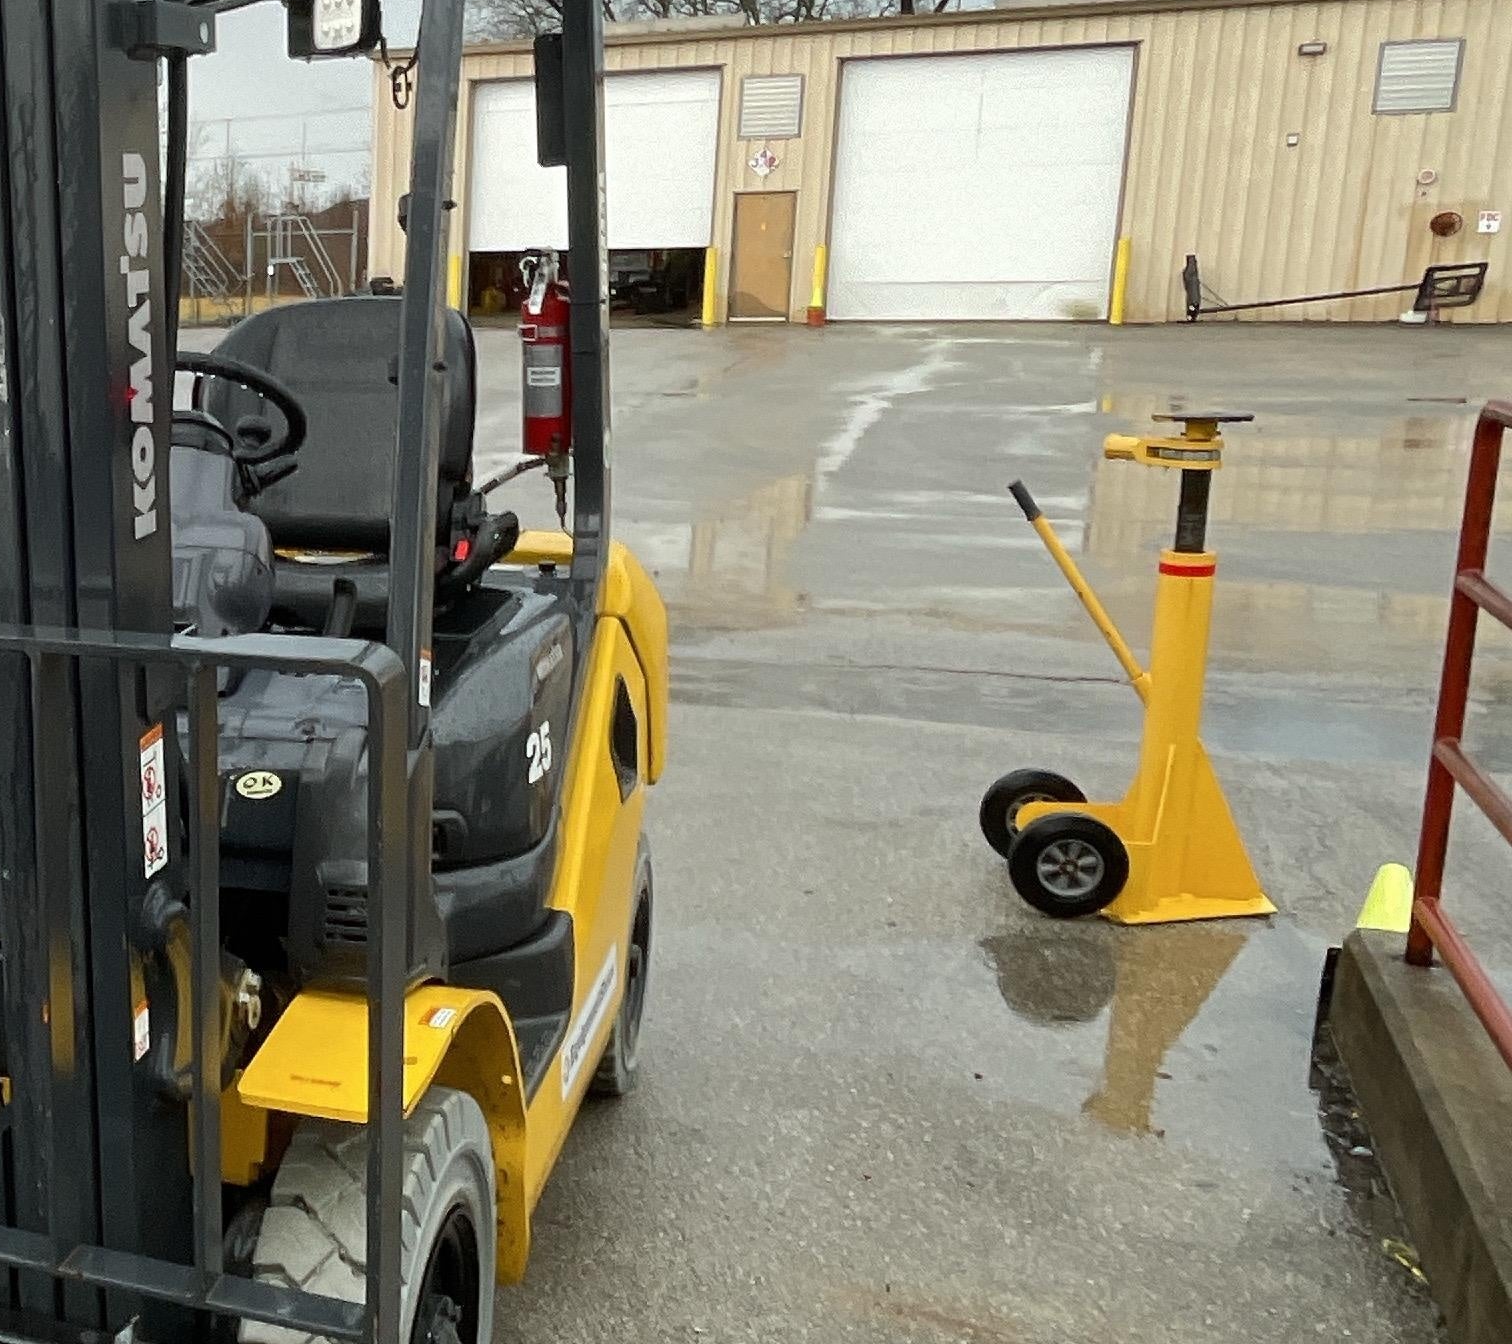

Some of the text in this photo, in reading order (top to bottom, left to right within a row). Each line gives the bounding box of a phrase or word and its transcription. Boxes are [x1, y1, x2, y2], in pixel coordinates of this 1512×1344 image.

[120, 153, 158, 540] KOMATSU
[243, 775, 274, 789] OK
[526, 720, 552, 784] 25
